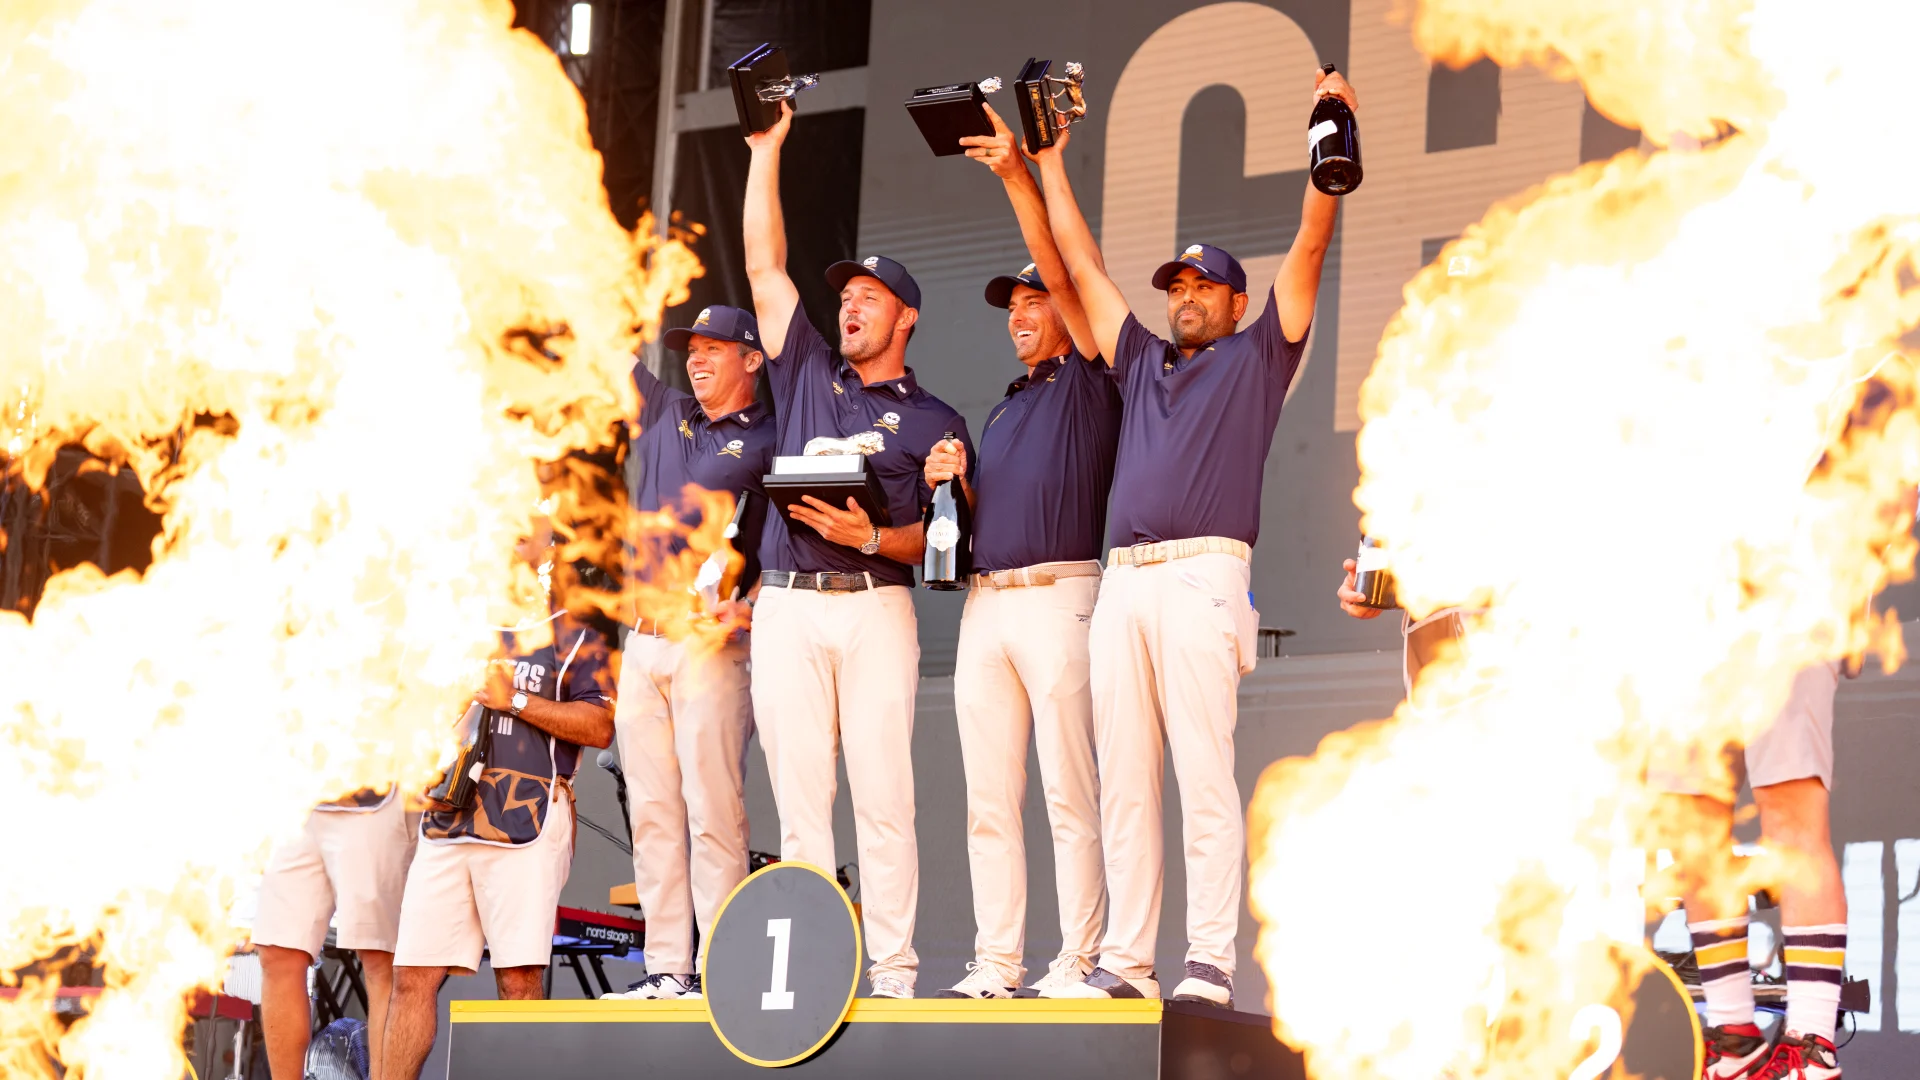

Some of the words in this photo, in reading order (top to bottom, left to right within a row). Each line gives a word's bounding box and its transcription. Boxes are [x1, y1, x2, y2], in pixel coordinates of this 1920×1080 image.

[586, 926, 606, 939] nord
[606, 929, 629, 944] stage
[628, 932, 634, 944] 3
[761, 918, 795, 1010] 1
[1568, 1003, 1623, 1080] 2
